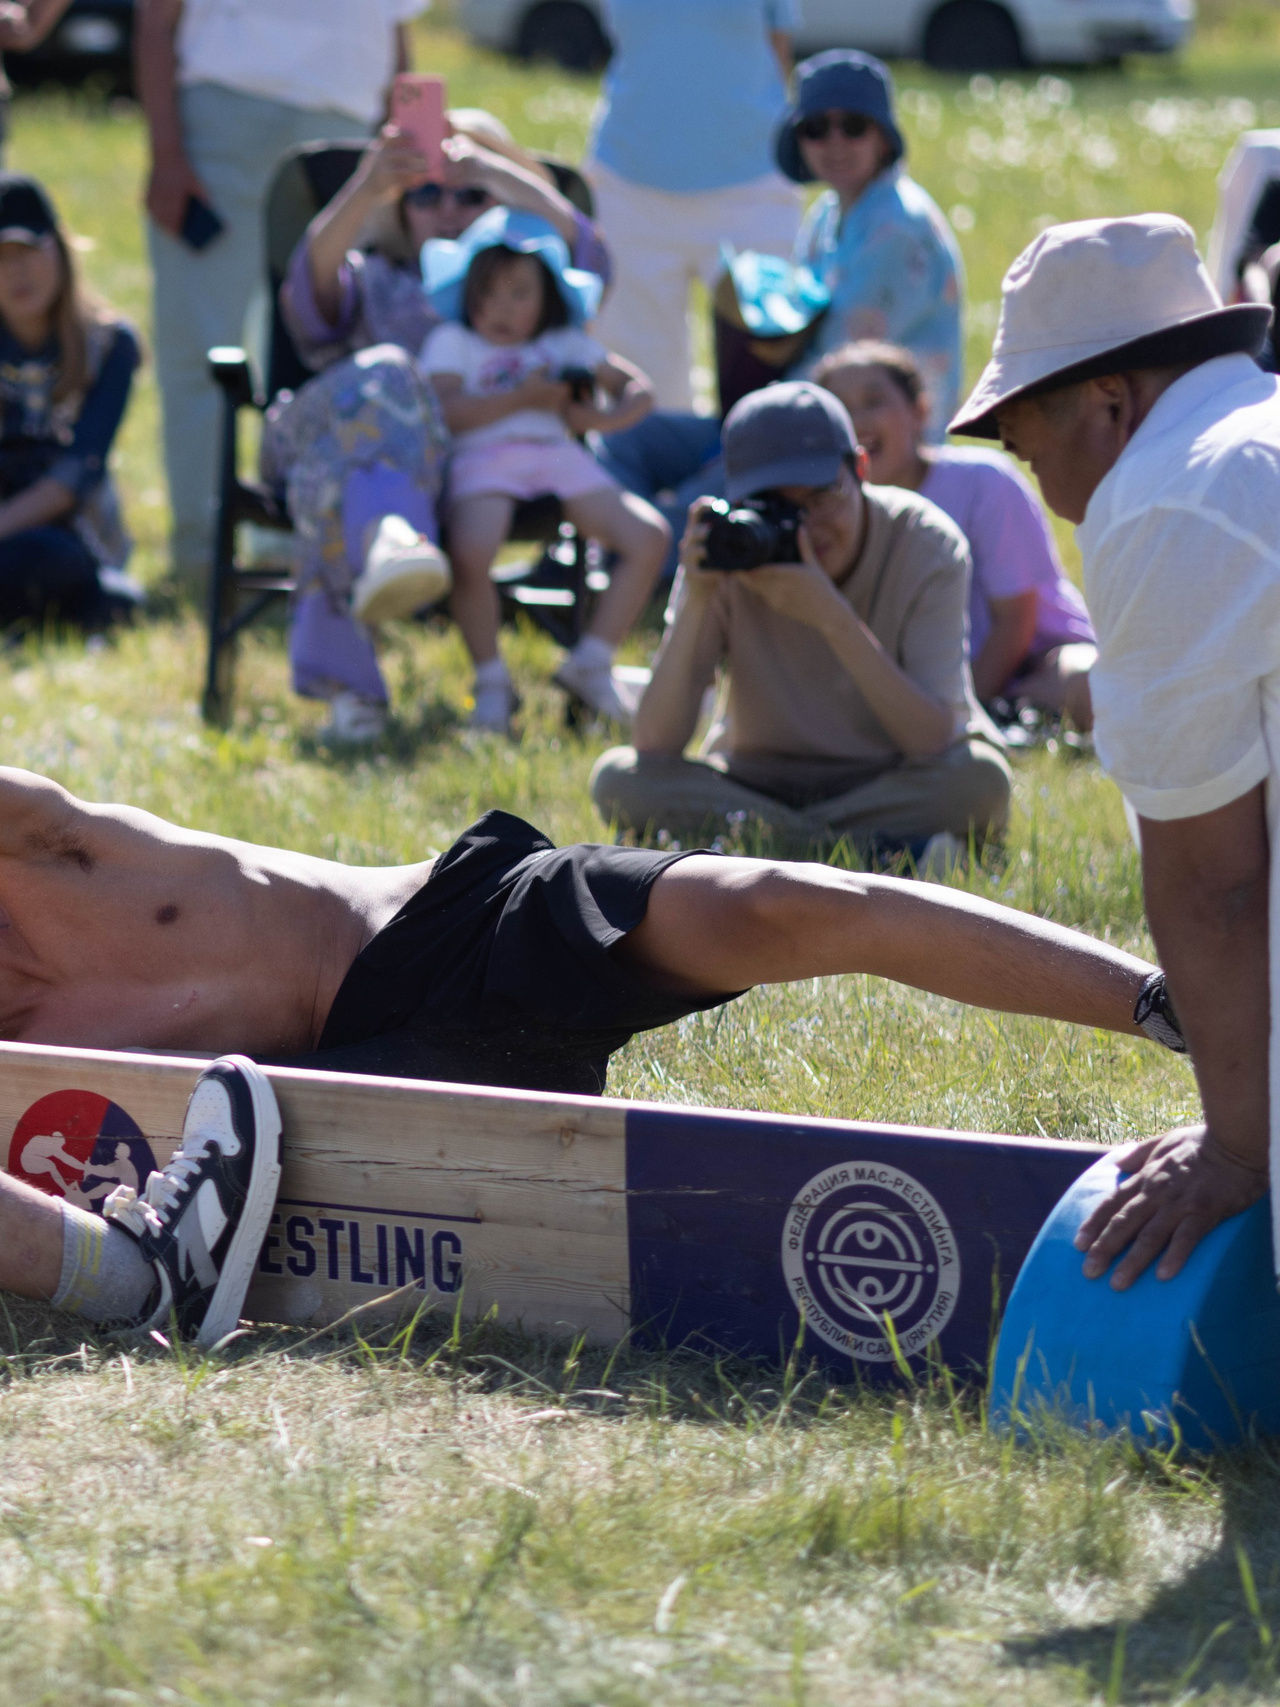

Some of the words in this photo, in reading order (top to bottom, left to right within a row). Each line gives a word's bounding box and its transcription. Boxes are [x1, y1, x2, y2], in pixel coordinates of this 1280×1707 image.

[258, 1212, 465, 1293] ESTLING
[788, 1169, 850, 1250] ФЕДЕРАЦИЯ
[854, 1167, 953, 1267] МАС-РЕСТЛИНГА
[792, 1276, 864, 1352] РЕСПУБЛИКИ
